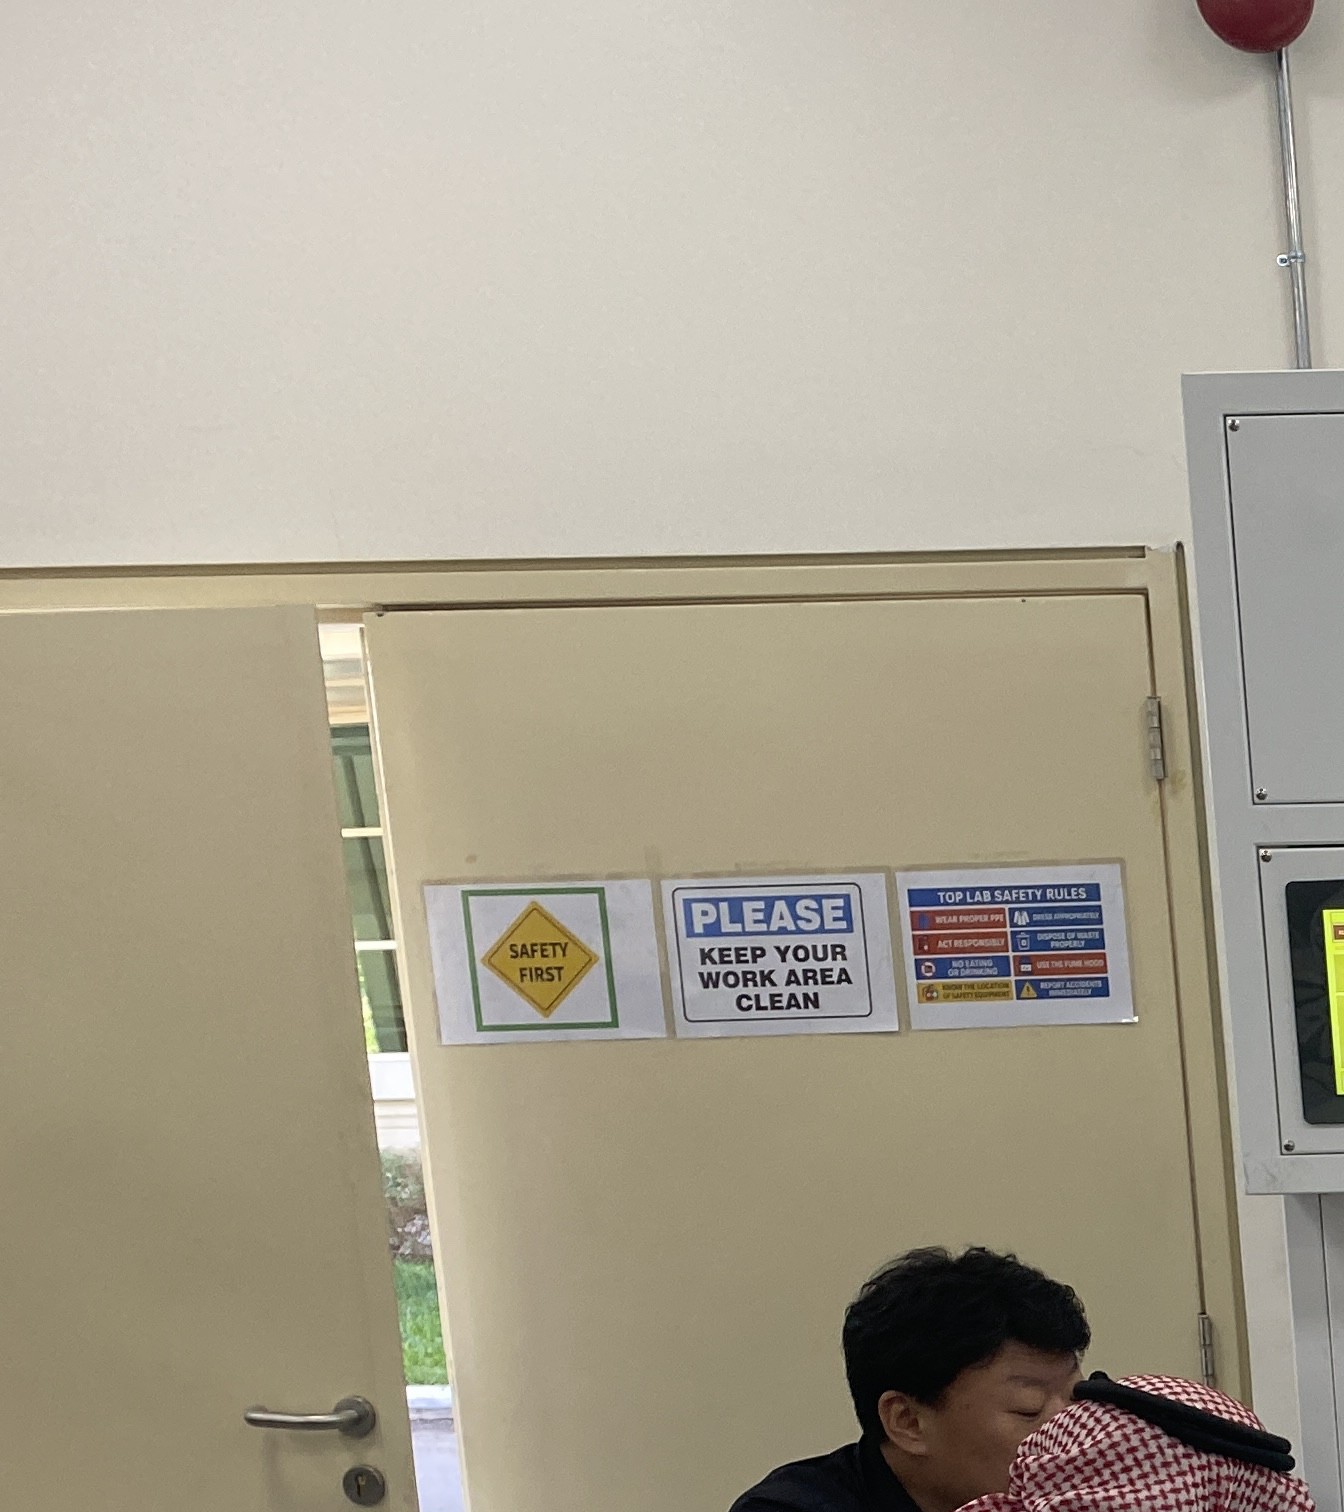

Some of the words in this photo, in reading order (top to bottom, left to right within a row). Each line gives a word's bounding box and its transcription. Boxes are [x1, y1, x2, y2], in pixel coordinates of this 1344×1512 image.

[937, 891, 962, 903] TOP
[966, 890, 991, 902] LAB
[995, 888, 1042, 901] SAFETY
[1047, 887, 1087, 899] RULES
[691, 898, 847, 934] PLEASE
[959, 914, 988, 922] PROPER
[509, 942, 568, 959] SAFETY
[938, 940, 952, 948] ACT
[699, 946, 766, 966] KEEP
[774, 944, 848, 963] YOUR
[952, 960, 964, 968] NO
[965, 959, 993, 967] EATING
[519, 966, 564, 983] FIRST
[698, 969, 777, 989] WORK
[785, 967, 853, 987] AREA
[947, 968, 959, 976] OR
[736, 992, 820, 1012] CLEAN
